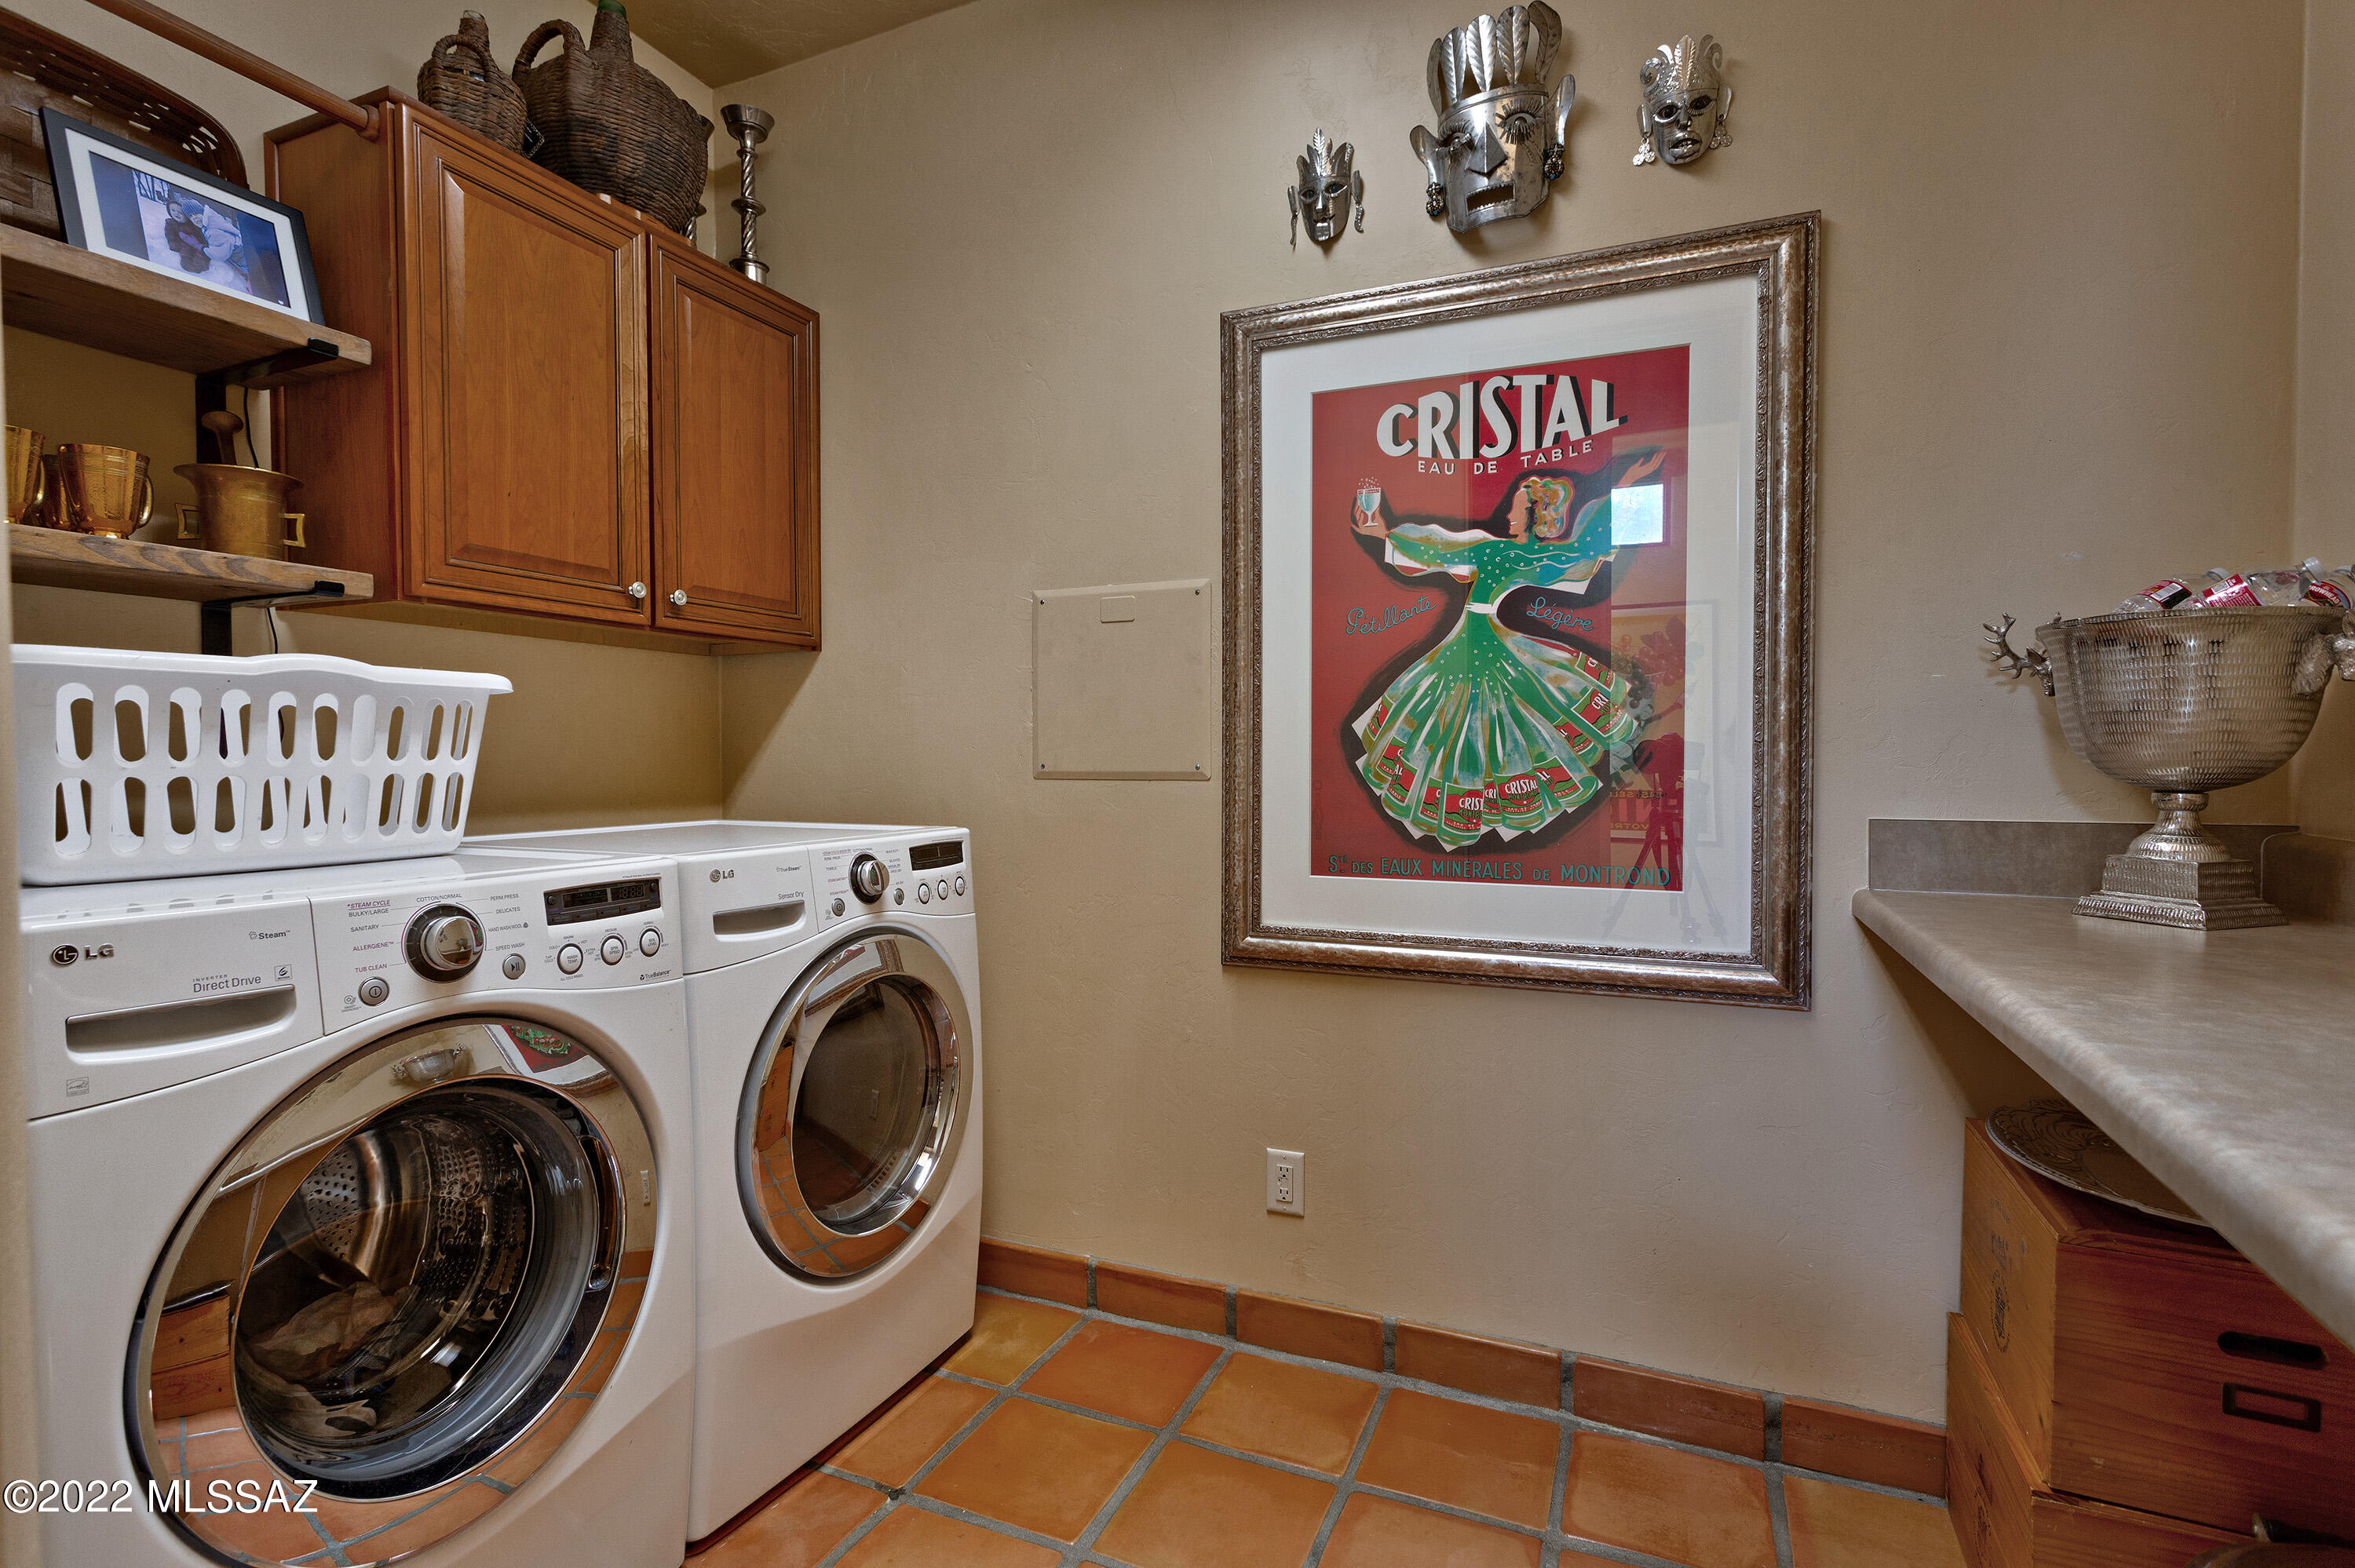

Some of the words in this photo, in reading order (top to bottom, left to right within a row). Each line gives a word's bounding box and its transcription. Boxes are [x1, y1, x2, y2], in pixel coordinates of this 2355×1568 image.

[1376, 374, 1627, 460] CRISTAL
[1418, 461, 1455, 475] EAU
[1473, 461, 1498, 475] DE
[1521, 439, 1594, 468] TABLE
[1345, 596, 1437, 635] Pétillante
[1526, 596, 1594, 631] Légère
[1505, 779, 1539, 794] CRISTAL
[722, 870, 734, 879] LG
[1352, 862, 1373, 873] DES
[1381, 857, 1422, 877] EAUX
[1432, 858, 1522, 880] MINÉRALES
[1533, 869, 1551, 881] DE
[1561, 863, 1670, 887] MONTROND
[417, 893, 462, 903] COTTON/NORMAL
[349, 908, 389, 917] BULKY/LARGE
[84, 943, 115, 960] LG
[193, 979, 230, 993] Direct
[232, 975, 261, 987] Drive
